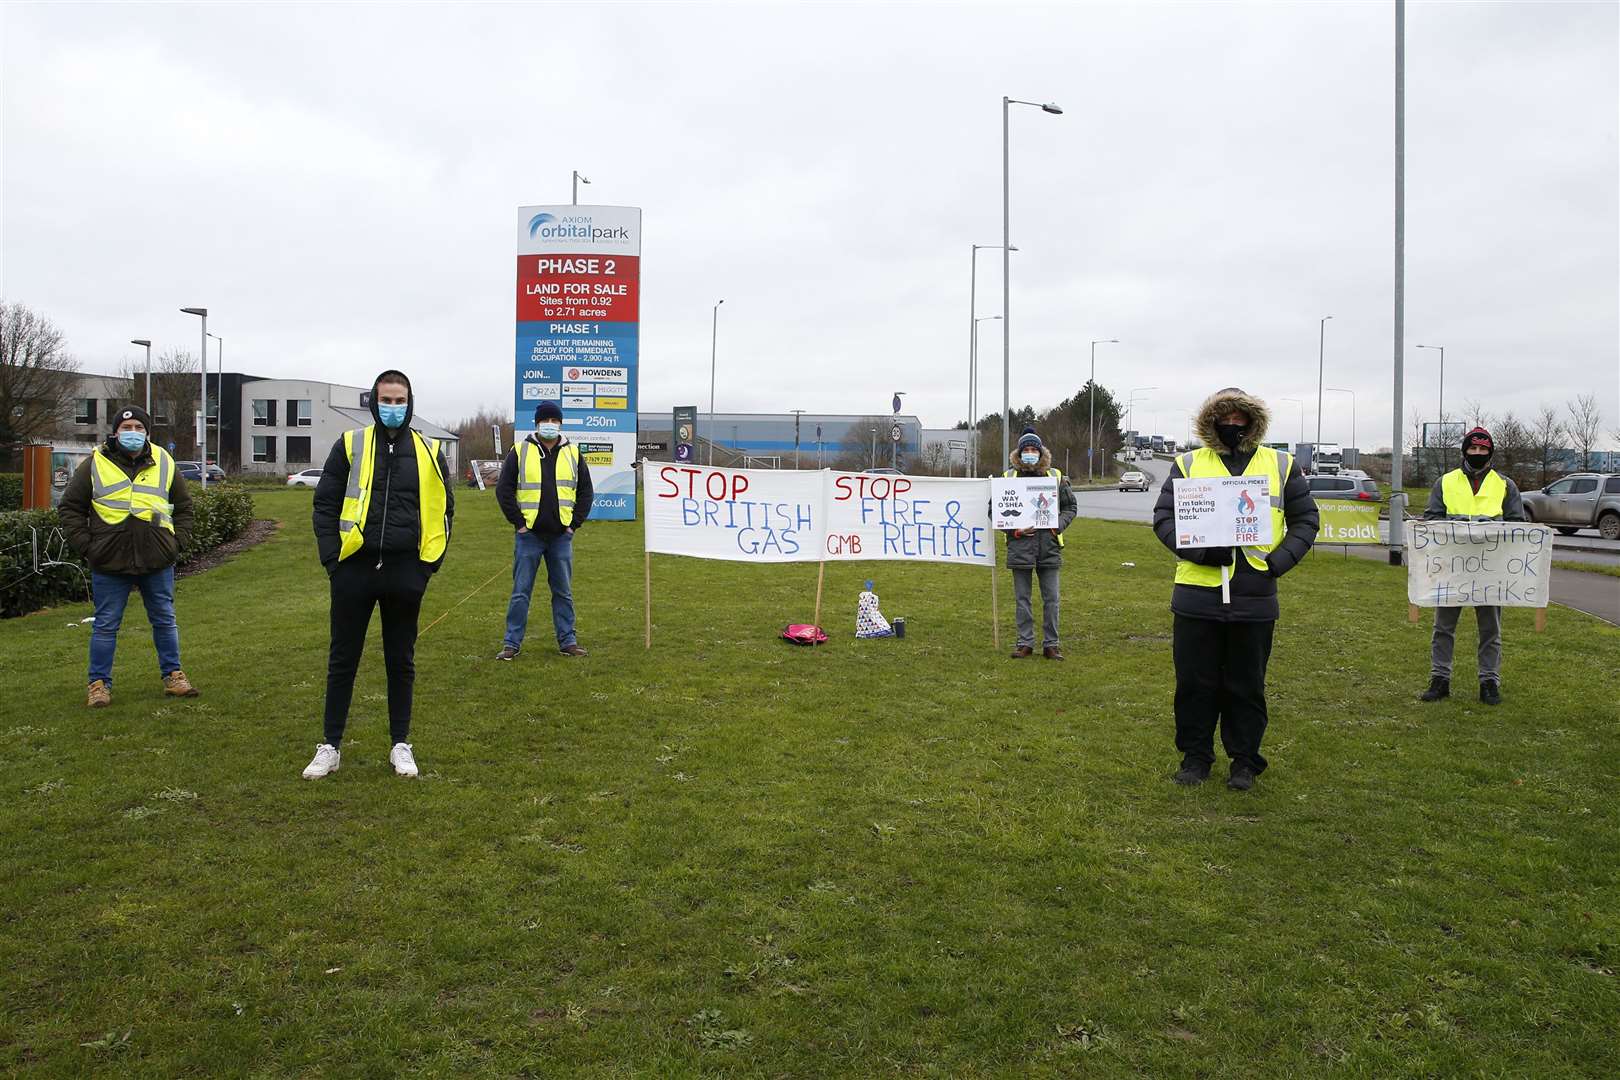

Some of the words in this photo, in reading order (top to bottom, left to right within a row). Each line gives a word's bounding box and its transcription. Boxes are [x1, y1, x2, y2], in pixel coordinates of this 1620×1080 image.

[541, 225, 629, 243] orbitalpark
[538, 259, 599, 274] PHASE
[604, 260, 616, 275] 2
[526, 284, 560, 295] LAND
[564, 284, 590, 295] FOR
[594, 285, 628, 295] SALE
[540, 296, 563, 305] Sites
[566, 296, 588, 305] from
[591, 297, 612, 306] 0.92
[544, 308, 554, 316] to
[556, 308, 576, 316] 2.71
[579, 309, 607, 317] acres
[550, 324, 590, 334] PHASE
[593, 324, 599, 334] 1
[523, 370, 551, 379] JOIN...
[582, 369, 622, 377] HOWDENS
[586, 415, 617, 427] 250m
[658, 466, 749, 501] STOP
[835, 476, 912, 501] STOP
[1190, 499, 1216, 507] taking
[682, 498, 812, 531] BRITISH
[861, 497, 933, 525] FIRE
[945, 500, 963, 528] &
[1235, 516, 1258, 524] STOP
[1235, 533, 1259, 542] FIRE
[1324, 523, 1334, 538] it
[1338, 524, 1377, 539] sold!
[737, 527, 800, 555] GAS
[826, 534, 862, 556] GMB
[883, 523, 986, 557] REHIRE
[1426, 554, 1442, 573] is
[1451, 550, 1497, 573] not
